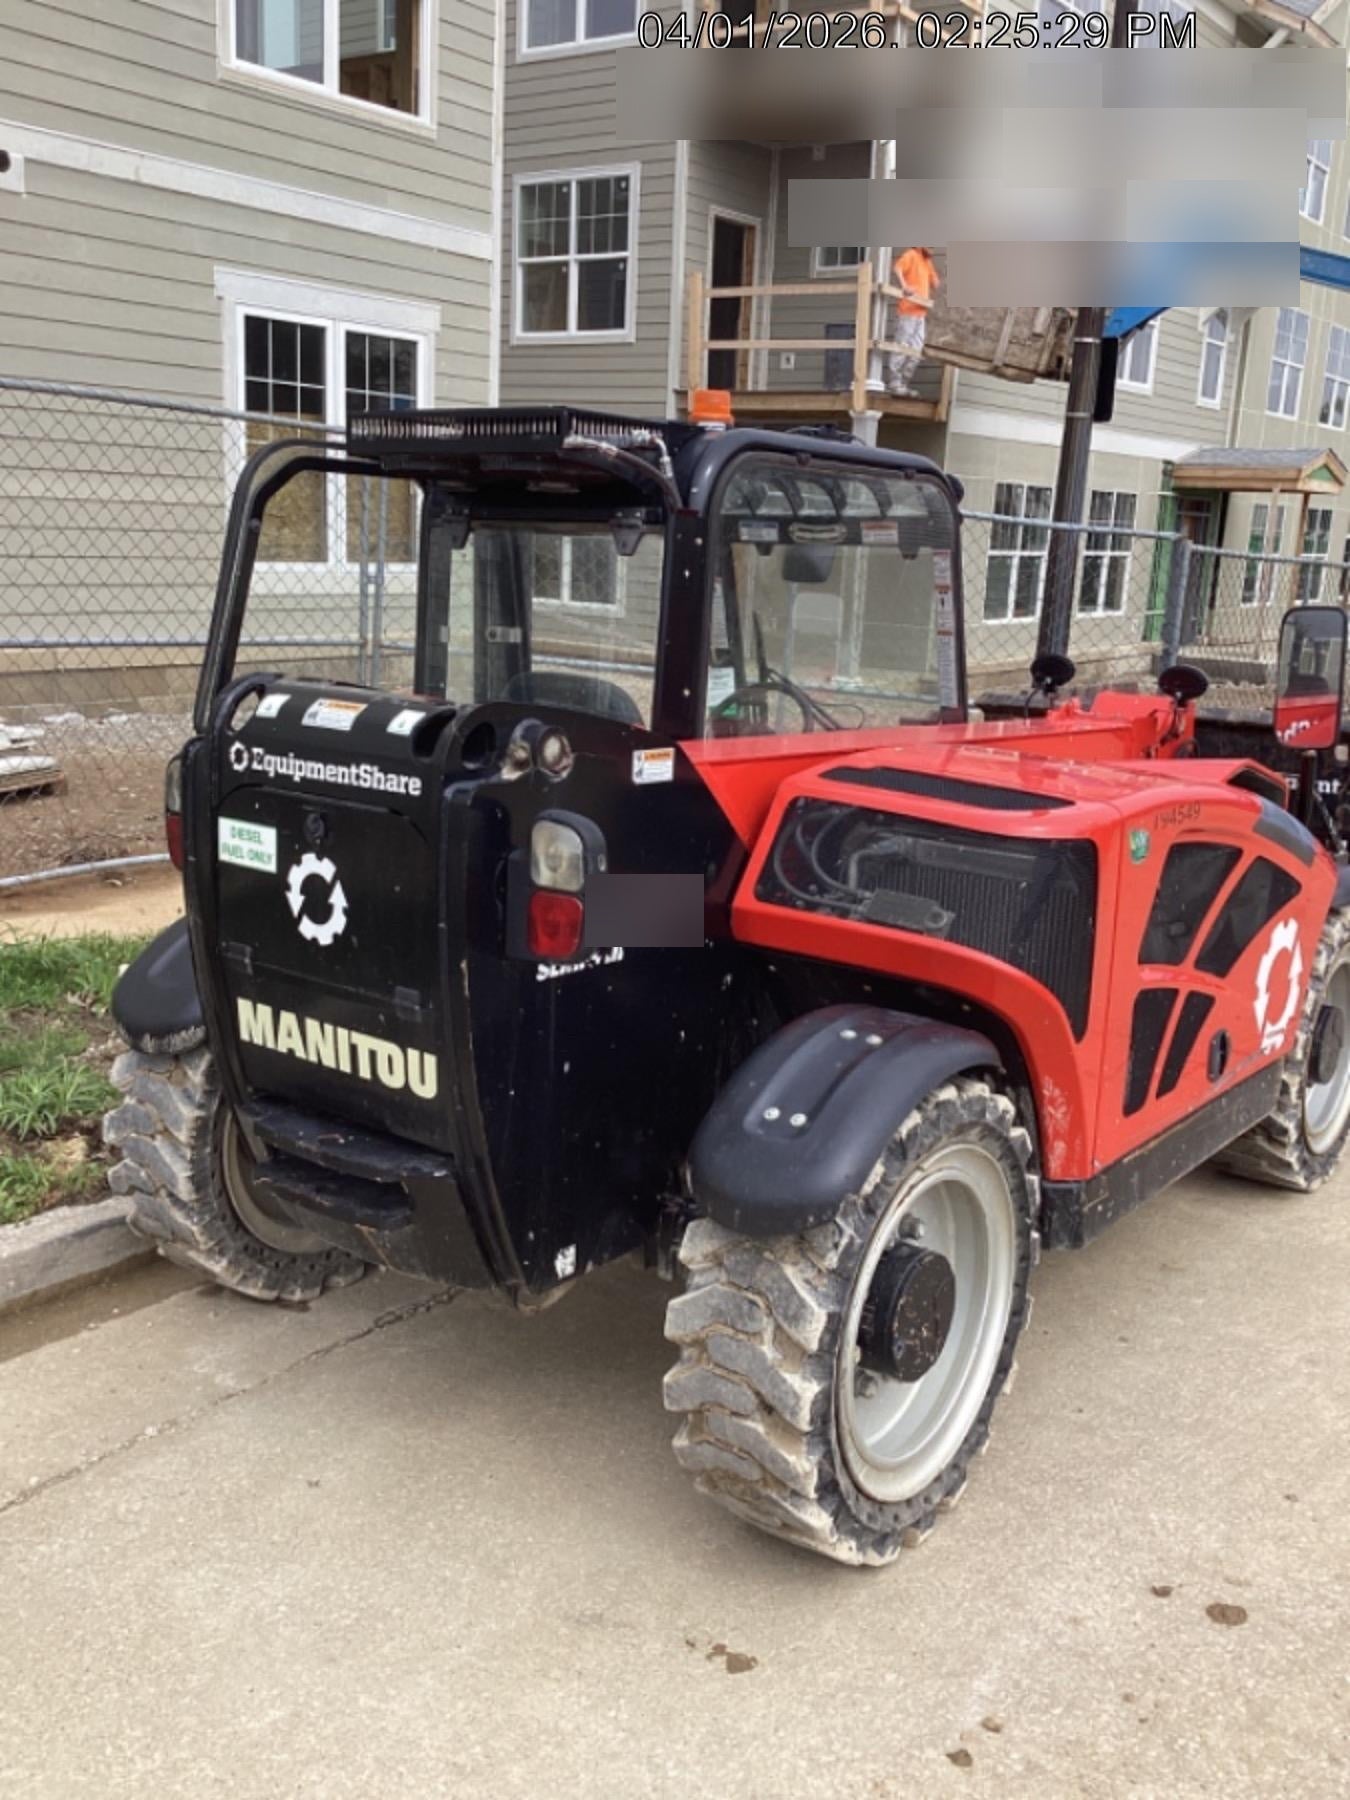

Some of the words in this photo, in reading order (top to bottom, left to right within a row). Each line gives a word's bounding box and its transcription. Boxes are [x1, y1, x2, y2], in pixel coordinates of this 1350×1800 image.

[250, 746, 422, 796] EquipmentShare
[221, 841, 245, 859] FUEL
[247, 847, 274, 866] ONLY
[230, 825, 264, 845] DIESEL
[237, 997, 439, 1099] MANITOU
